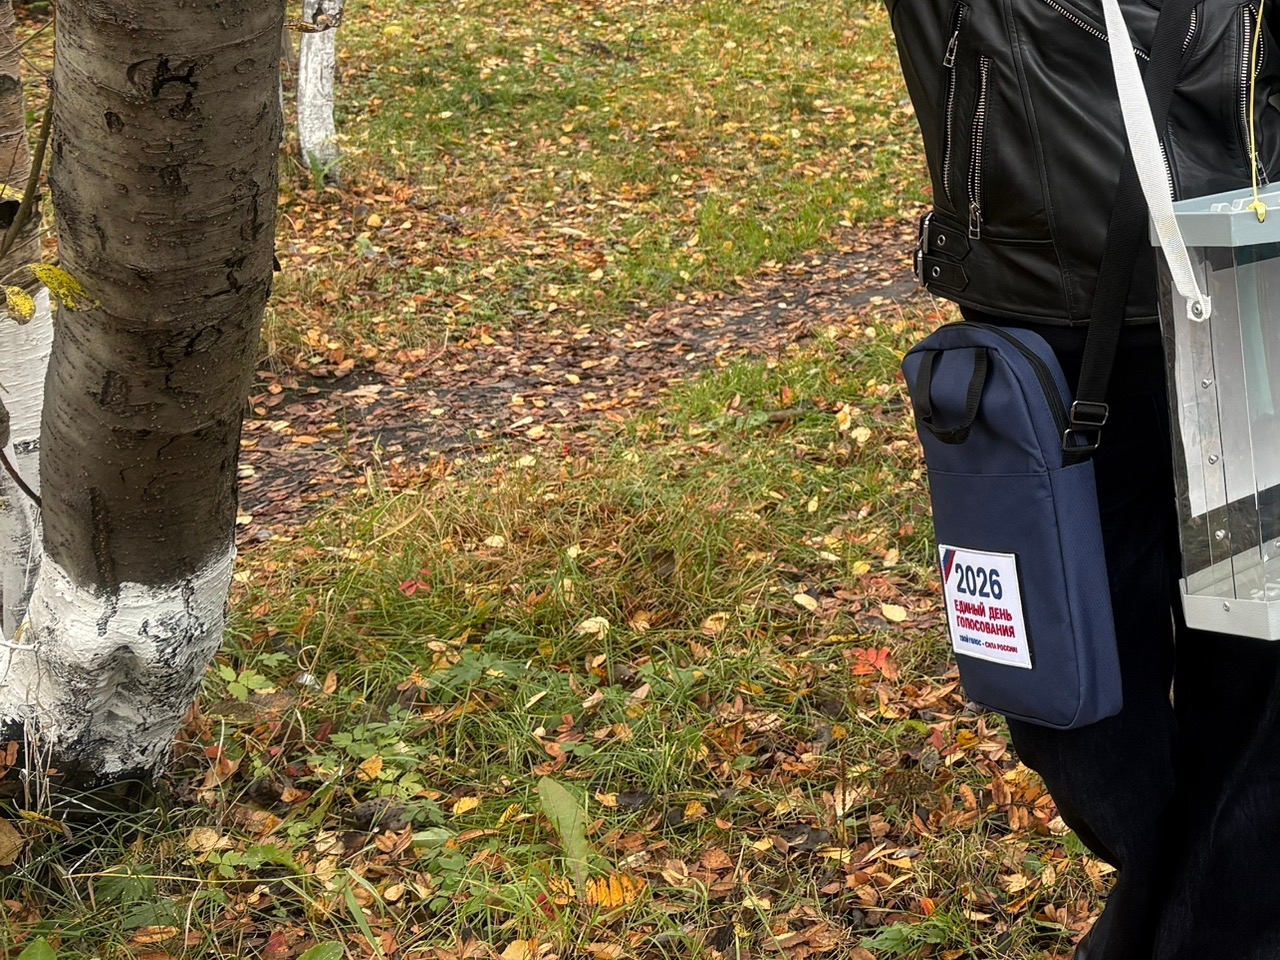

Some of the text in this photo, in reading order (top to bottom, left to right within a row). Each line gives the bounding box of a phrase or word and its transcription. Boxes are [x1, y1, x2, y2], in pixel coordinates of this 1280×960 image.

[954, 562, 1003, 600] 2026
[953, 599, 1013, 622] ЕДИНЫЙ ДЕНЬ
[956, 615, 1016, 638] ГОЛОСОВАНИЯ
